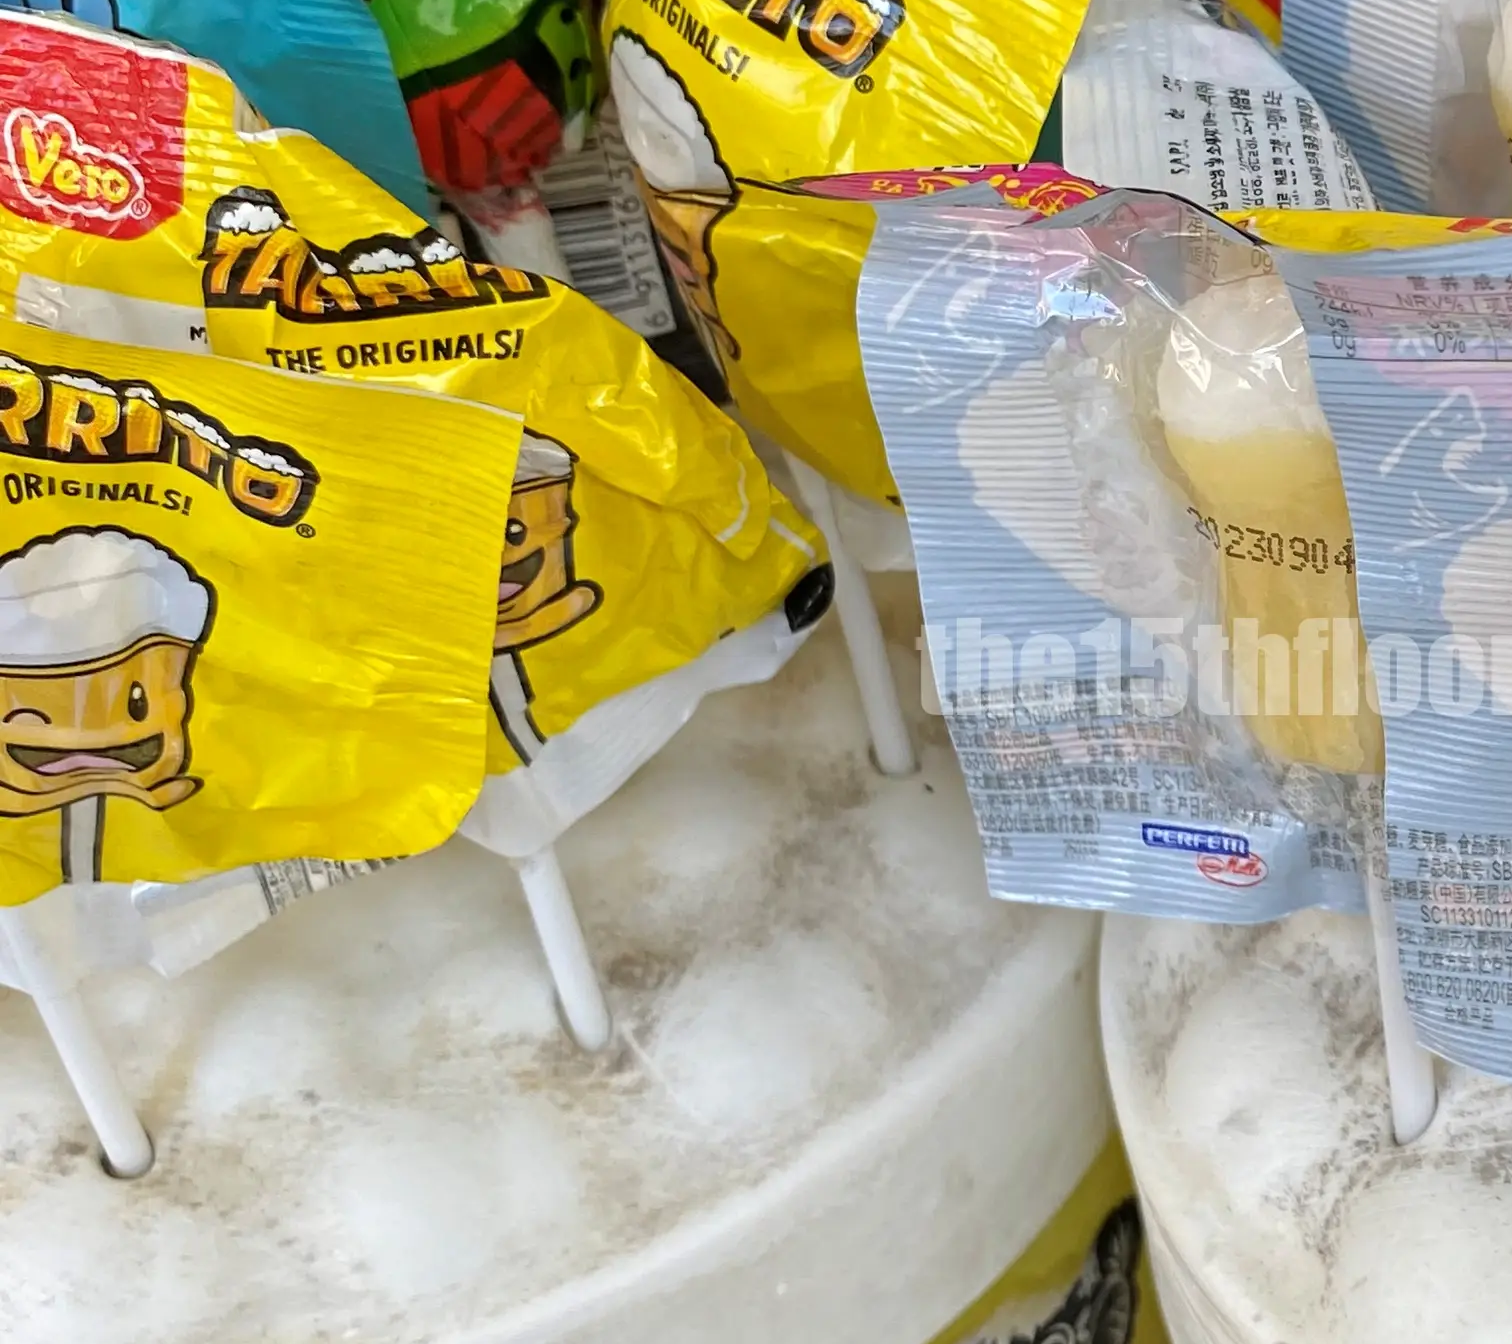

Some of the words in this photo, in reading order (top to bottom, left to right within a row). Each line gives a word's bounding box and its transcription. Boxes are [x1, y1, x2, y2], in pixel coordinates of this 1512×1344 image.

[18, 125, 133, 206] Vero
[1396, 291, 1466, 316] NRV%
[336, 329, 524, 370] ORIGINALS!
[1434, 331, 1468, 357] 0%
[3, 470, 194, 517] ORIGINALS!
